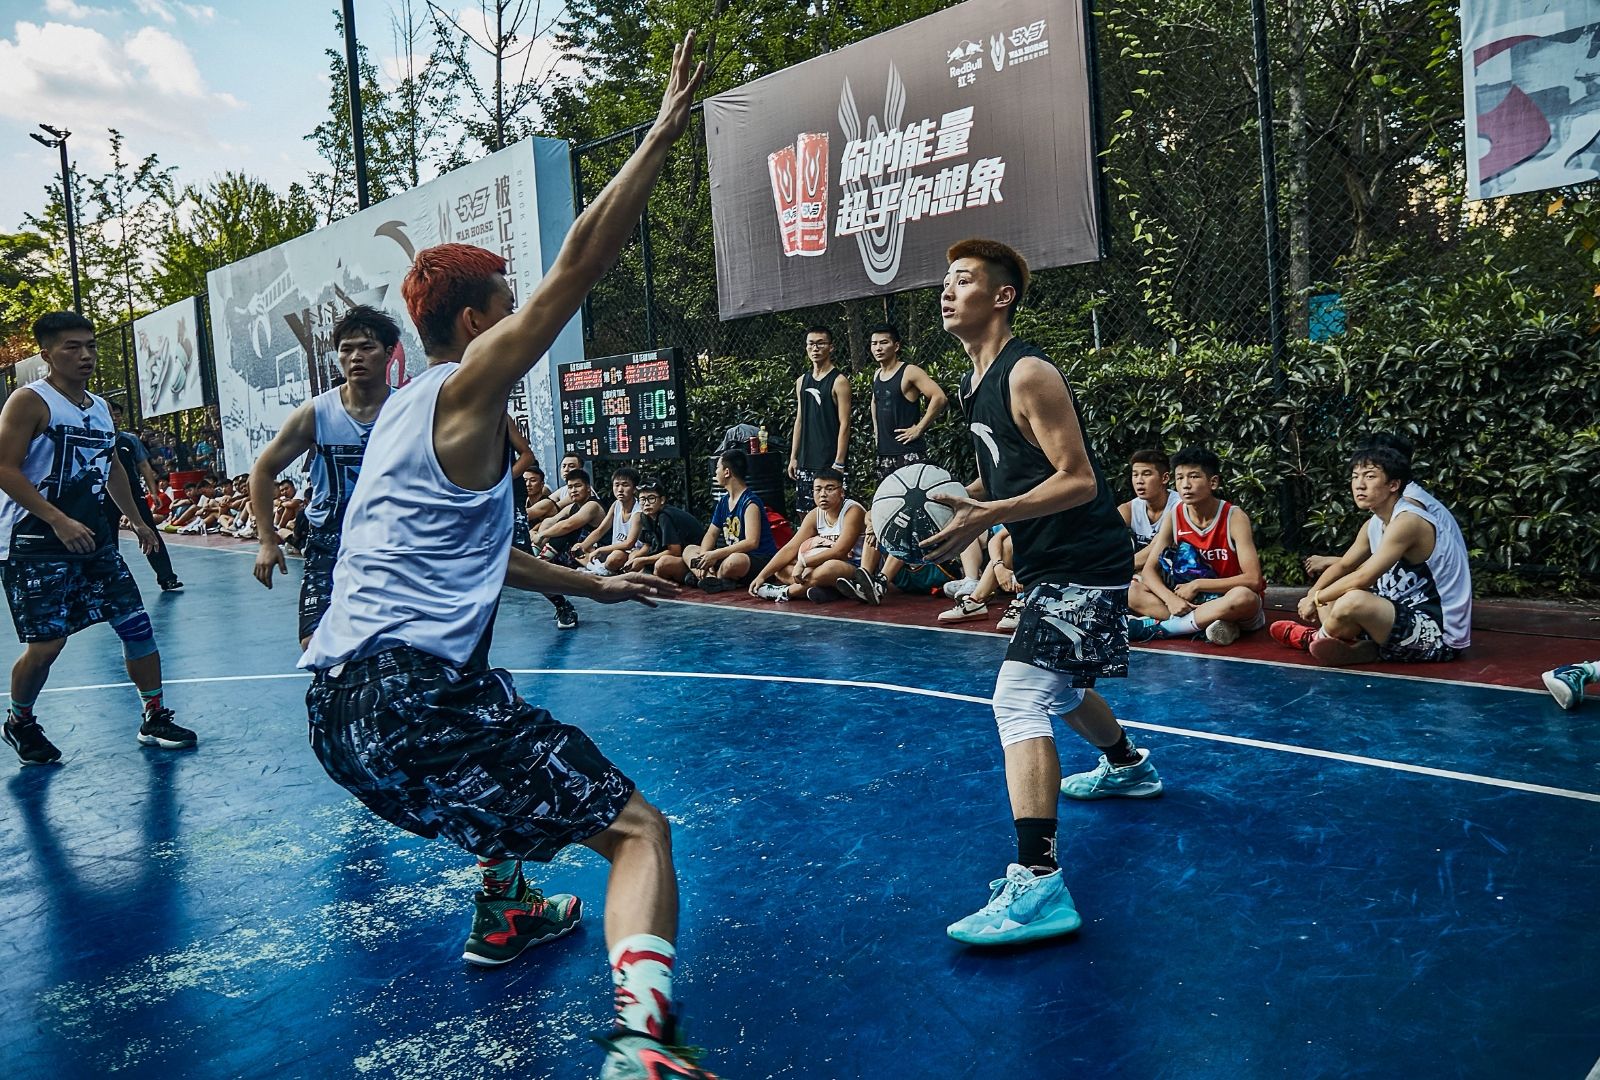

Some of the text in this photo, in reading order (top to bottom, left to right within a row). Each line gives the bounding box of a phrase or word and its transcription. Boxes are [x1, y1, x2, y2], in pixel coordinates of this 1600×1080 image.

[949, 57, 982, 78] RedBull
[957, 73, 976, 88] 红牛
[839, 105, 974, 186] 你的能量
[834, 156, 1006, 237] 超乎你想象
[455, 228, 470, 241] WAR
[470, 220, 494, 237] HORSE
[1200, 548, 1229, 561] KETS
